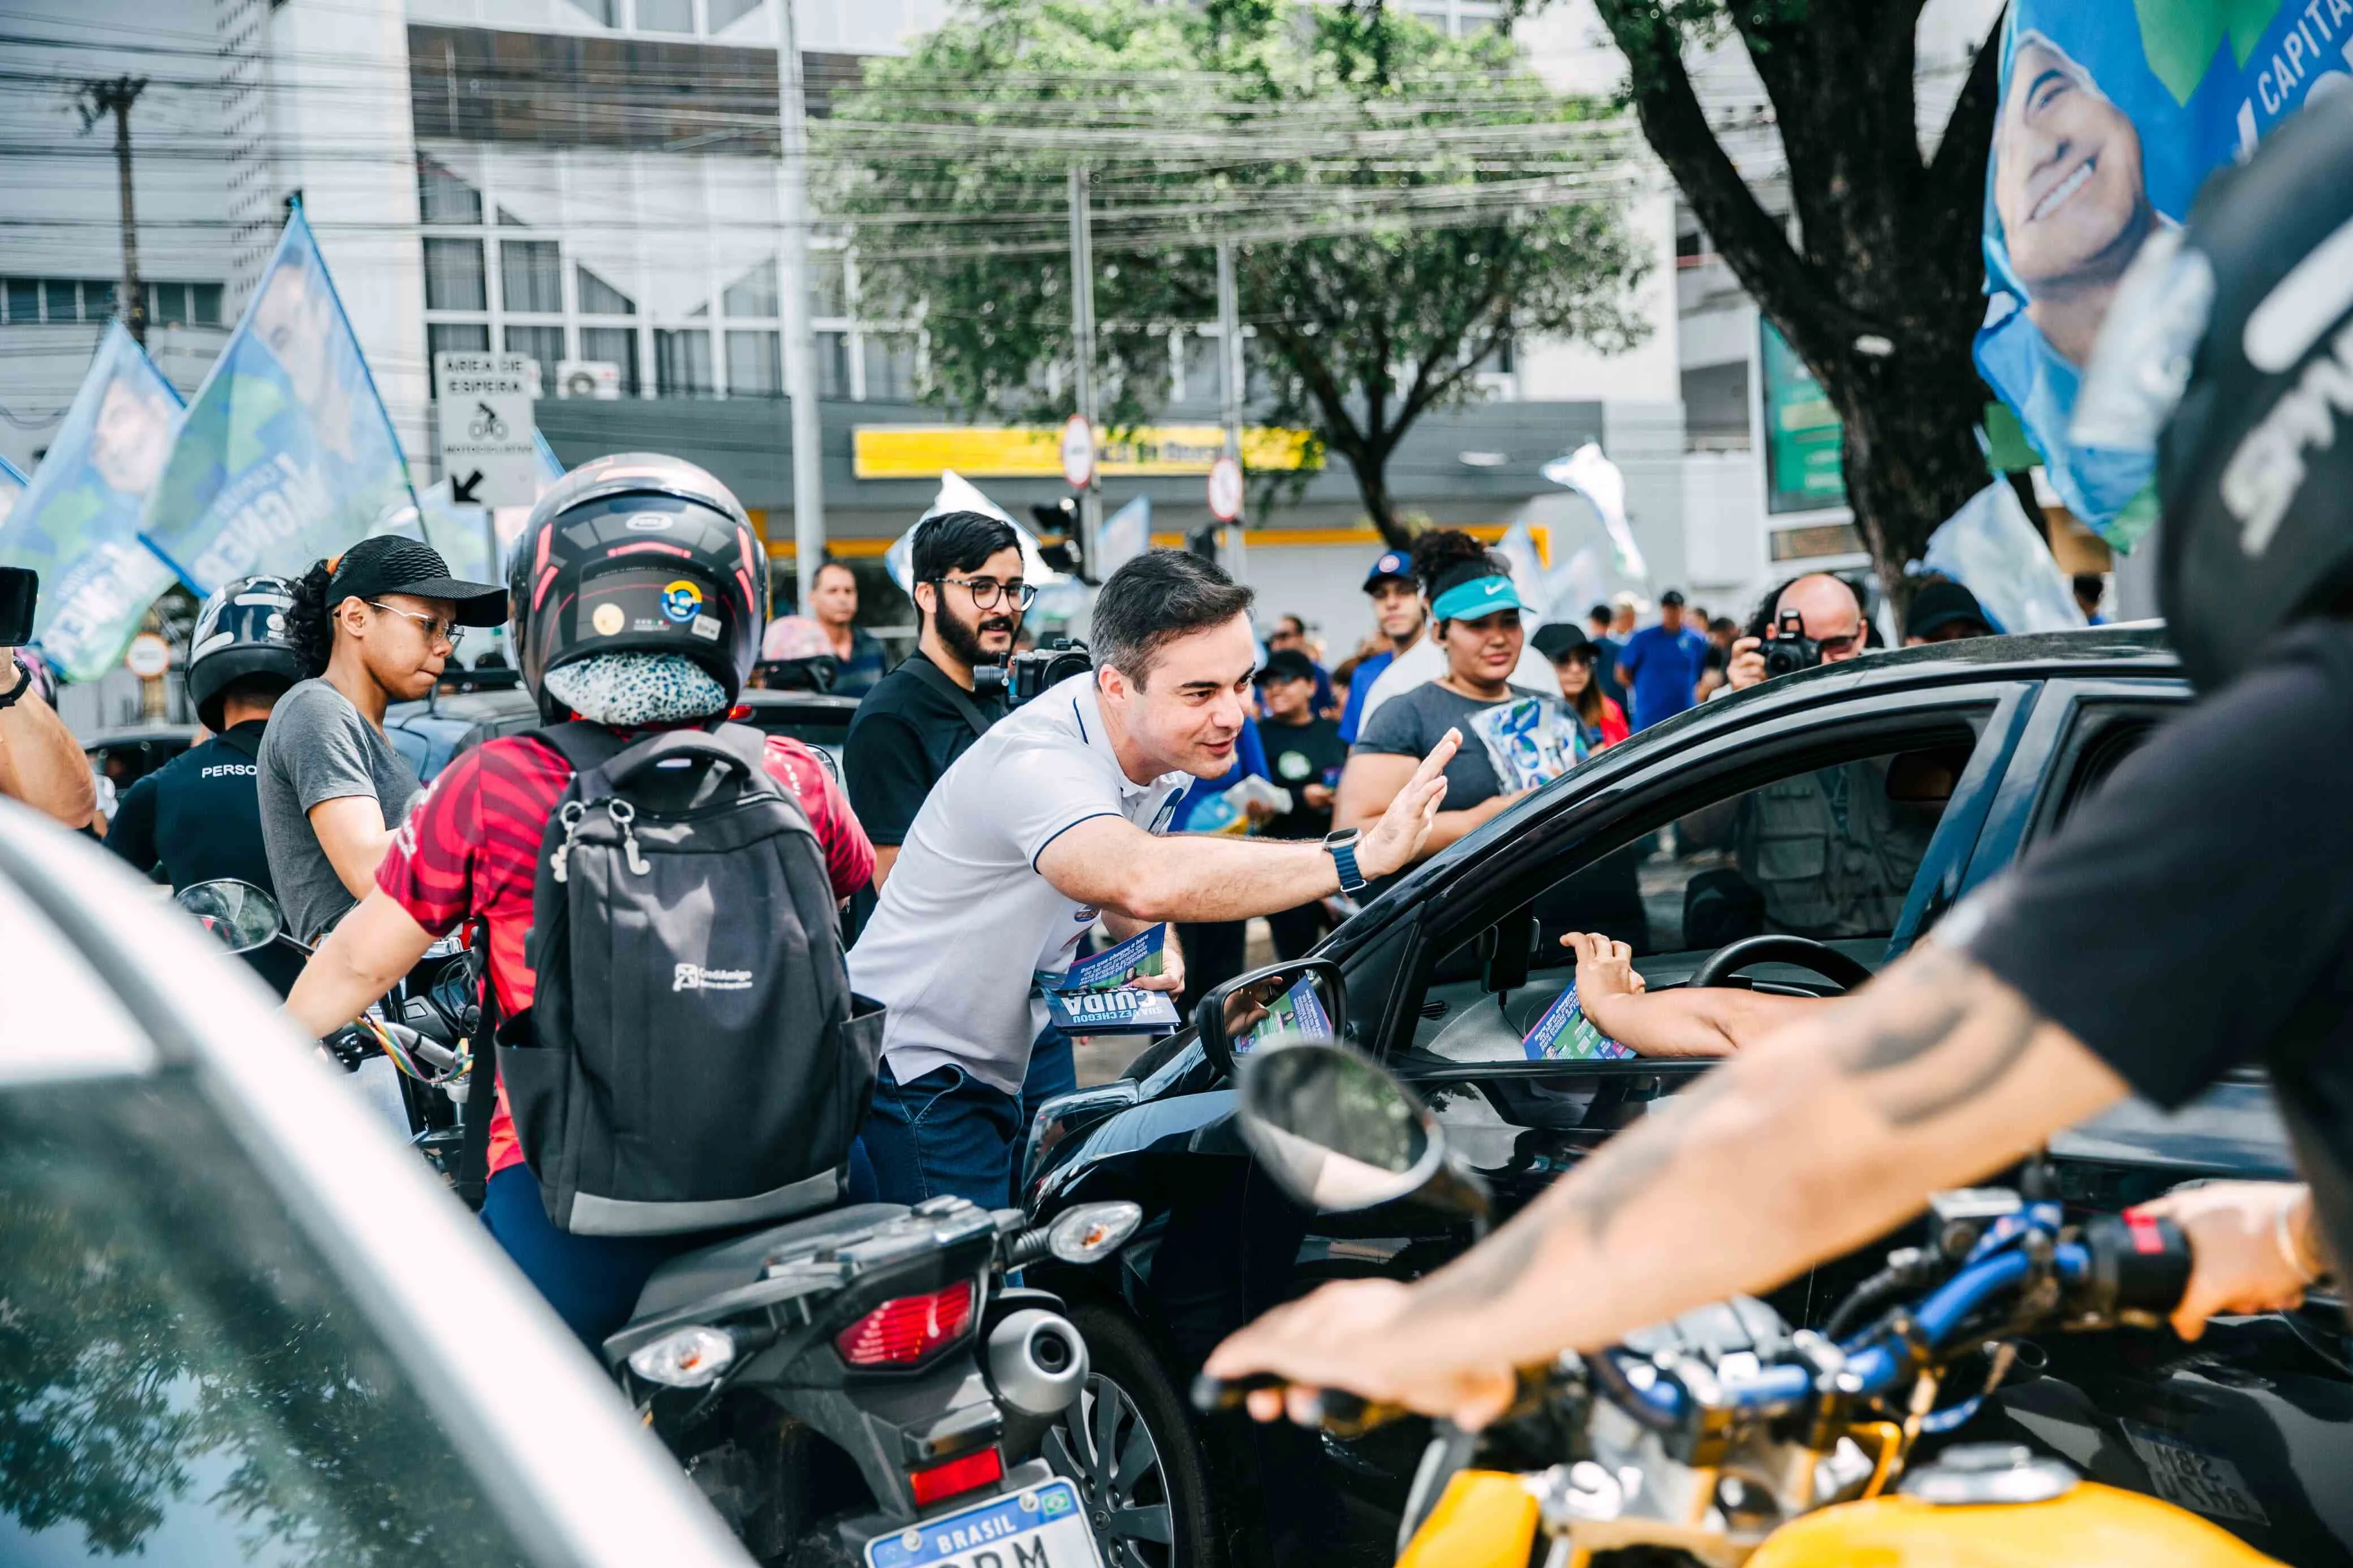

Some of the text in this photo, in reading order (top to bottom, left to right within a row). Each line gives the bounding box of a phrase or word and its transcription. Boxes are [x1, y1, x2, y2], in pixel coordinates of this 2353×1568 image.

[449, 381, 522, 393] ESPERA
[202, 764, 257, 778] PERSO
[1109, 945, 1130, 961] chegou
[1136, 934, 1149, 945] hora
[1061, 990, 1156, 1016] CUIDA
[1072, 1007, 1163, 1023] SUA VEZ CHEGOU
[936, 1514, 1017, 1554] BRASIL
